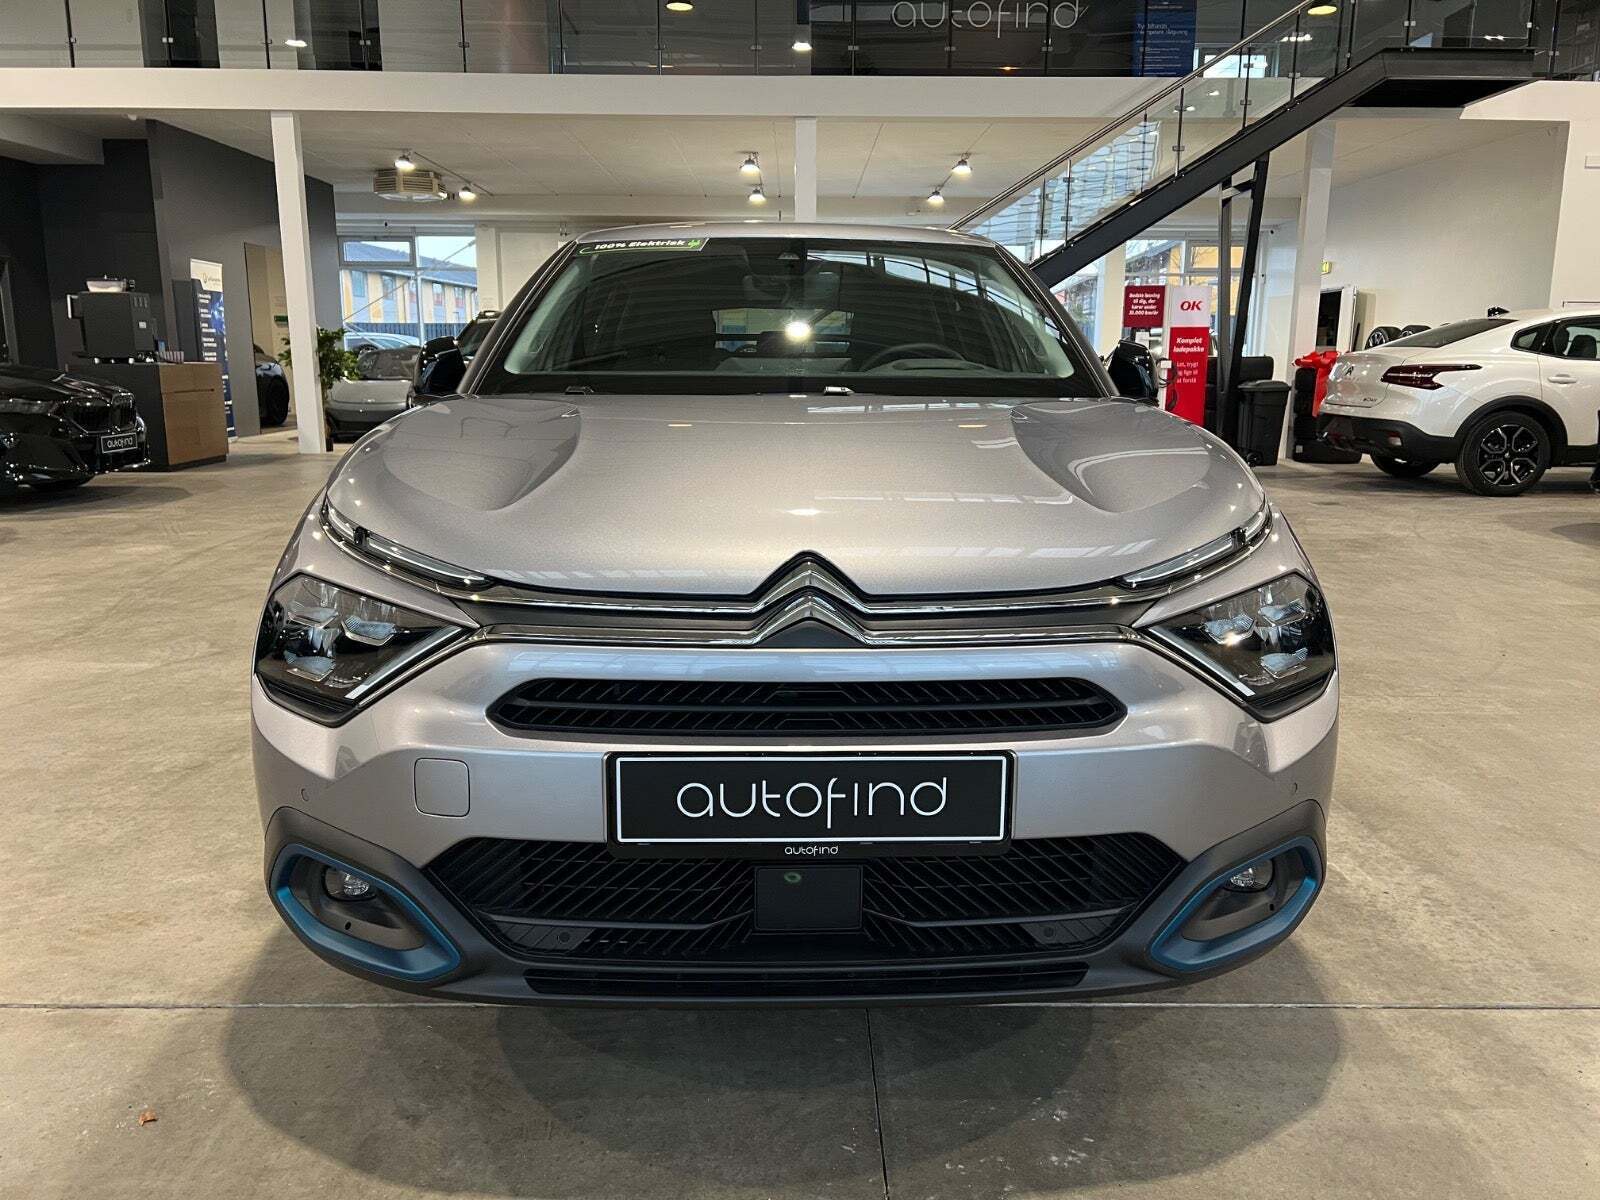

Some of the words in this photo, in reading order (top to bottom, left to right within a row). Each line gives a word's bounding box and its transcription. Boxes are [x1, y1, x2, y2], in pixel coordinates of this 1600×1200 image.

[594, 242, 626, 250] 100%
[628, 239, 686, 248] Elektrisk
[1180, 300, 1203, 311] OK
[1176, 337, 1203, 346] Komplet
[677, 777, 947, 829] autofind
[784, 845, 839, 856] autofind
